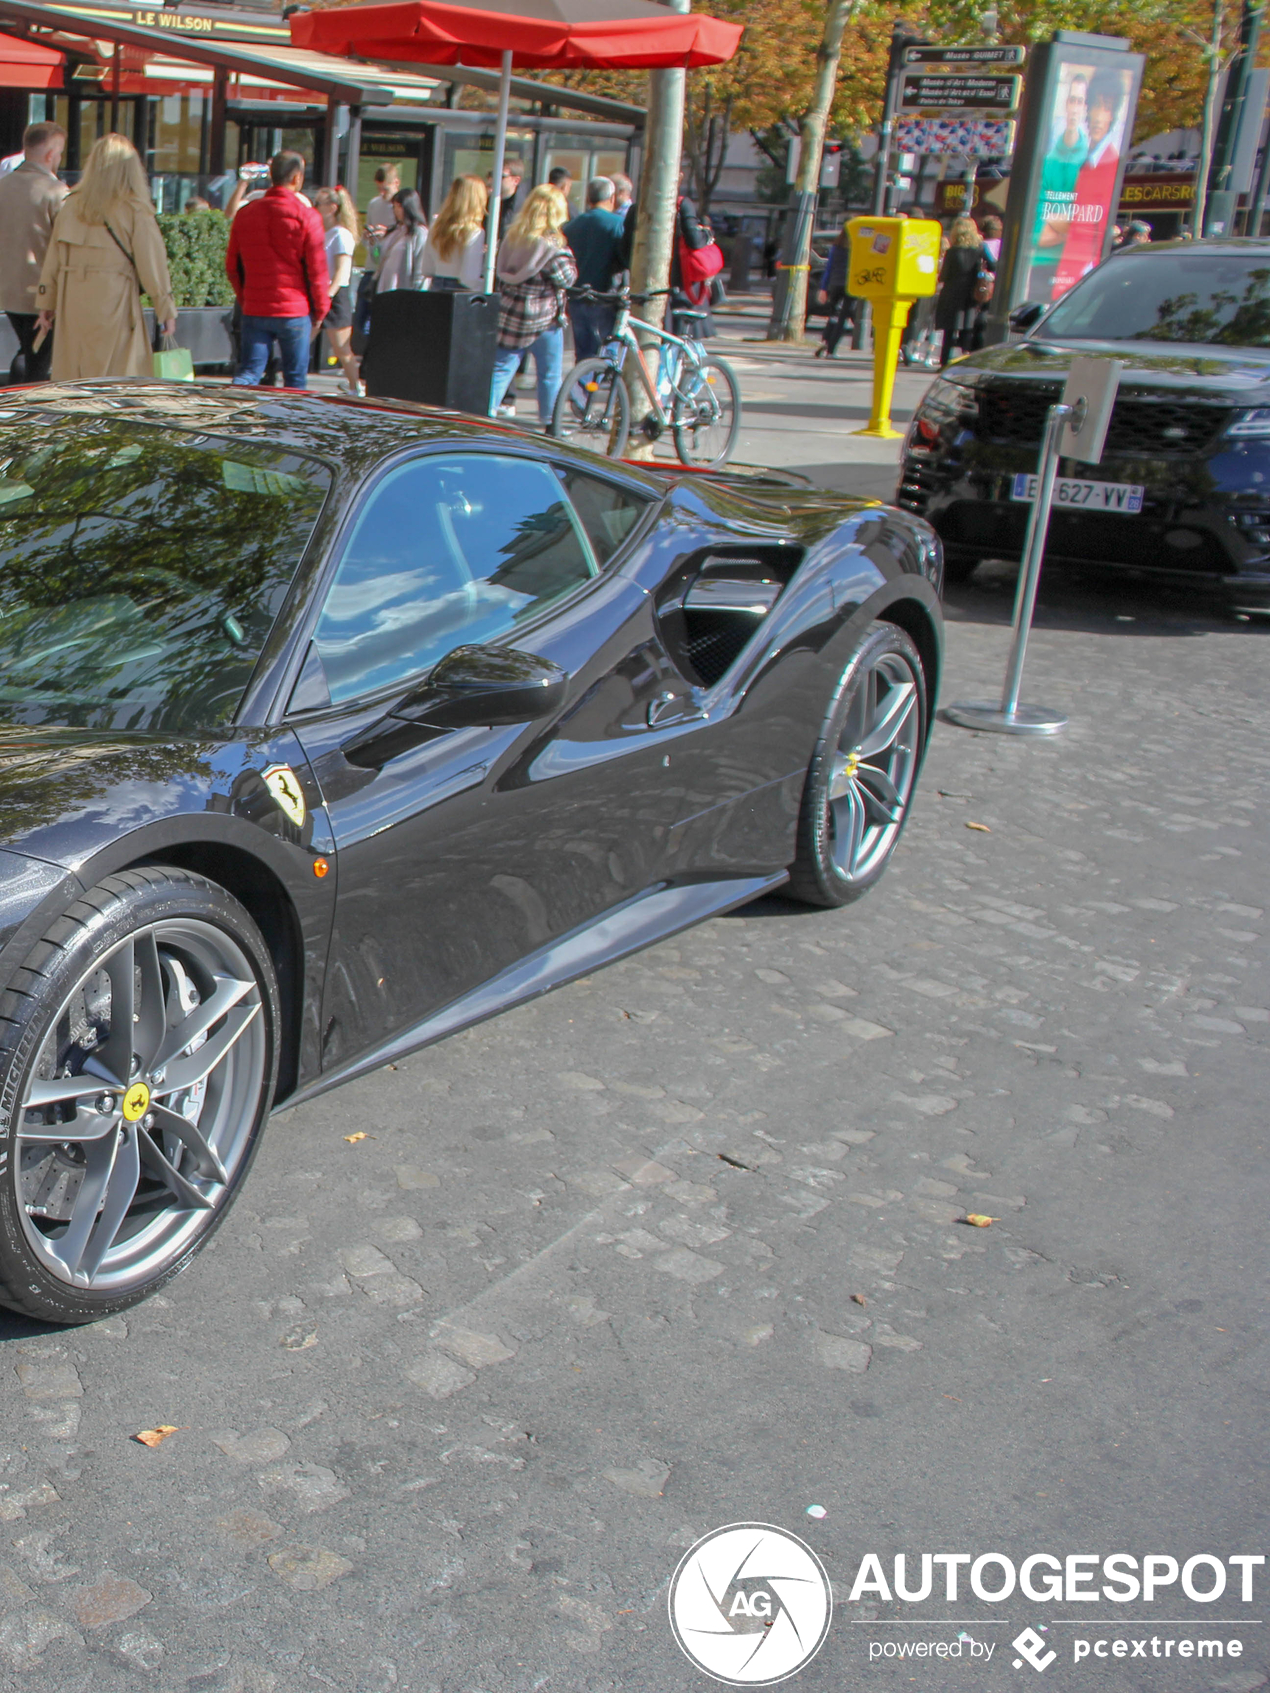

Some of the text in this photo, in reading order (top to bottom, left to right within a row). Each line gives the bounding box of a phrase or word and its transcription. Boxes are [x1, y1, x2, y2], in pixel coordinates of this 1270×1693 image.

[136, 11, 212, 32] LE WILSON
[945, 50, 1005, 60] Musée GUIMET
[945, 184, 965, 197] BIG
[1042, 201, 1104, 223] BOMPARD
[1026, 477, 1128, 509] E-627-VV
[0, 1004, 51, 1114] MICHELIN
